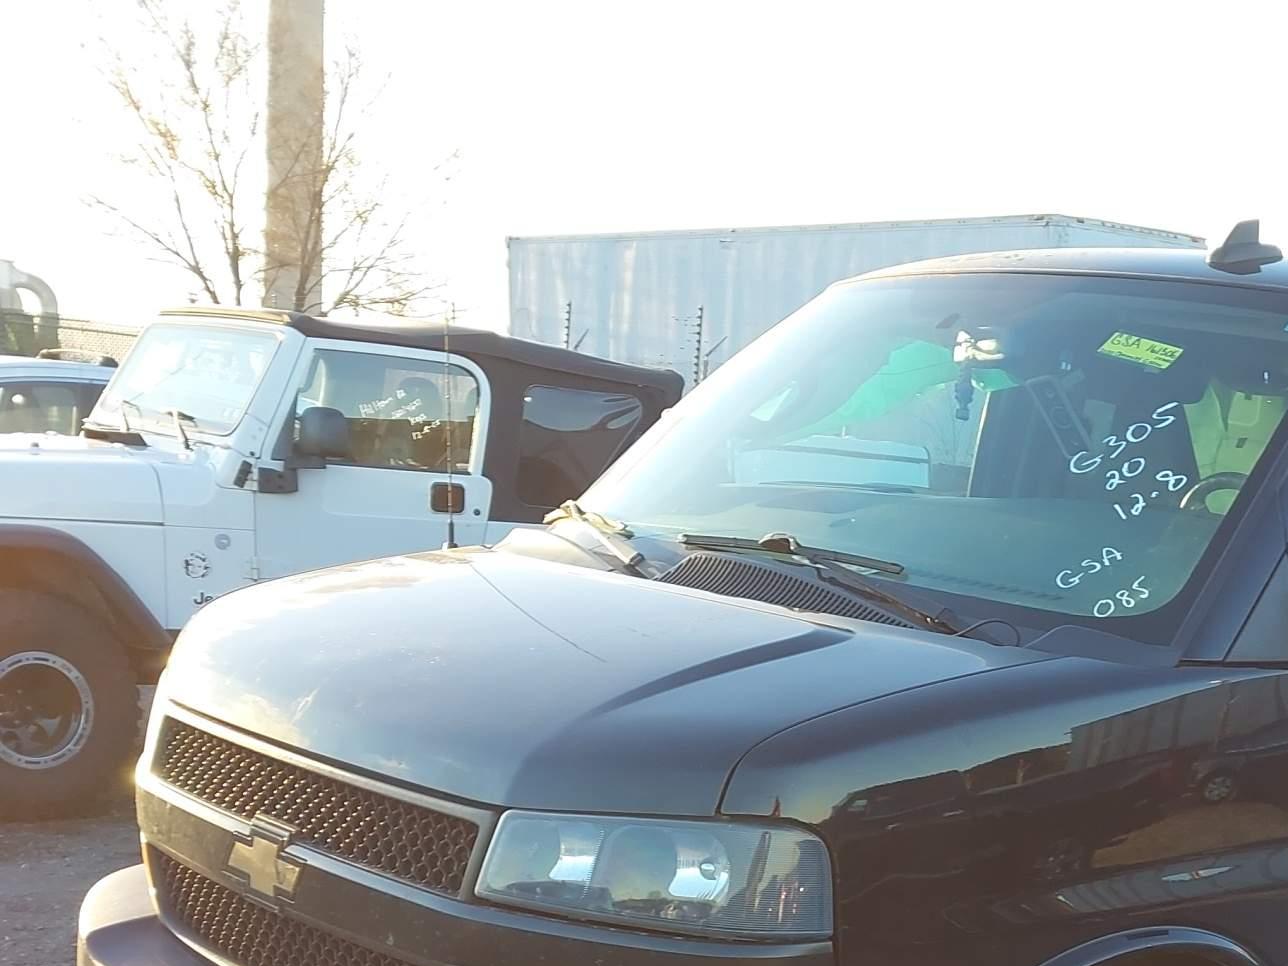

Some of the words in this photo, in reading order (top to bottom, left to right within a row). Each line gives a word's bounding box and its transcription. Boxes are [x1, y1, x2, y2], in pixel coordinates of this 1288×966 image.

[1105, 457, 1146, 490] 20
[1056, 547, 1124, 589] GSA
[1093, 575, 1151, 617] 085
